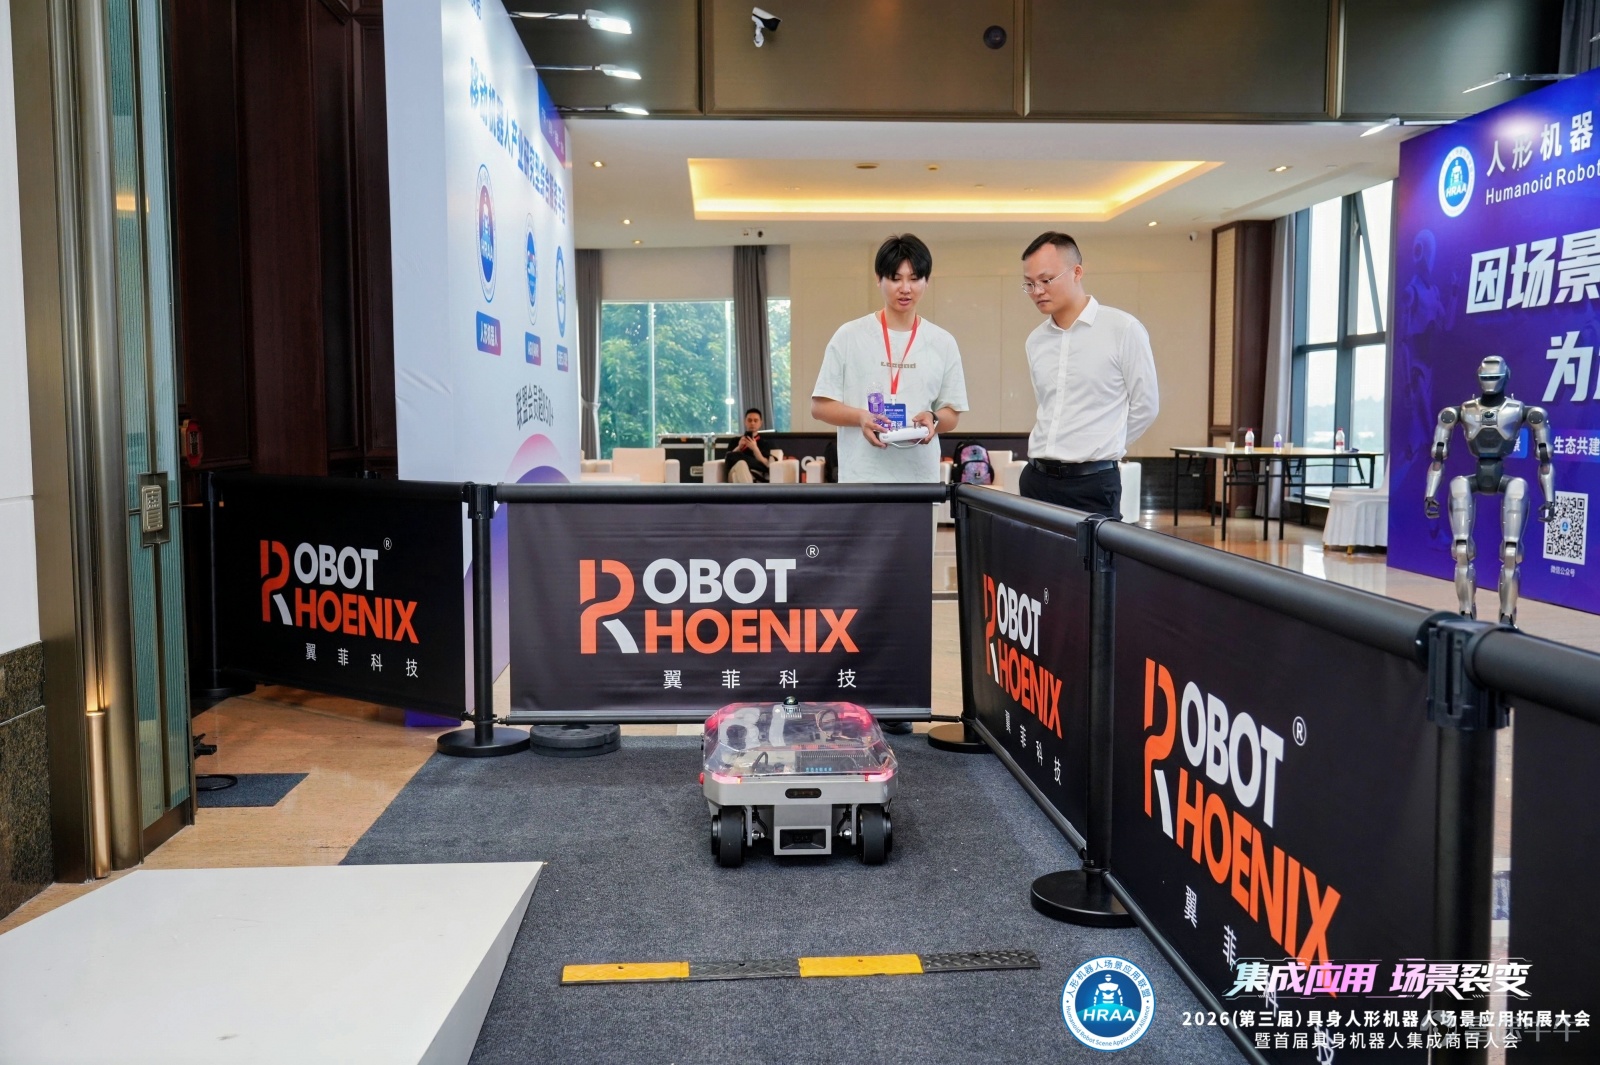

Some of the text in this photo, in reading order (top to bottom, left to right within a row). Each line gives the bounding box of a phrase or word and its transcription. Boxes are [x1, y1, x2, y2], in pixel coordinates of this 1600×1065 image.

[1486, 110, 1593, 177] 人形机器
[1445, 183, 1467, 198] HRAA
[1485, 171, 1552, 205] Humanoid
[1466, 229, 1600, 314] 因场景
[1553, 435, 1600, 456] 生态共建
[306, 642, 419, 678] 翼菲科技
[662, 668, 858, 690] 翼菲科技
